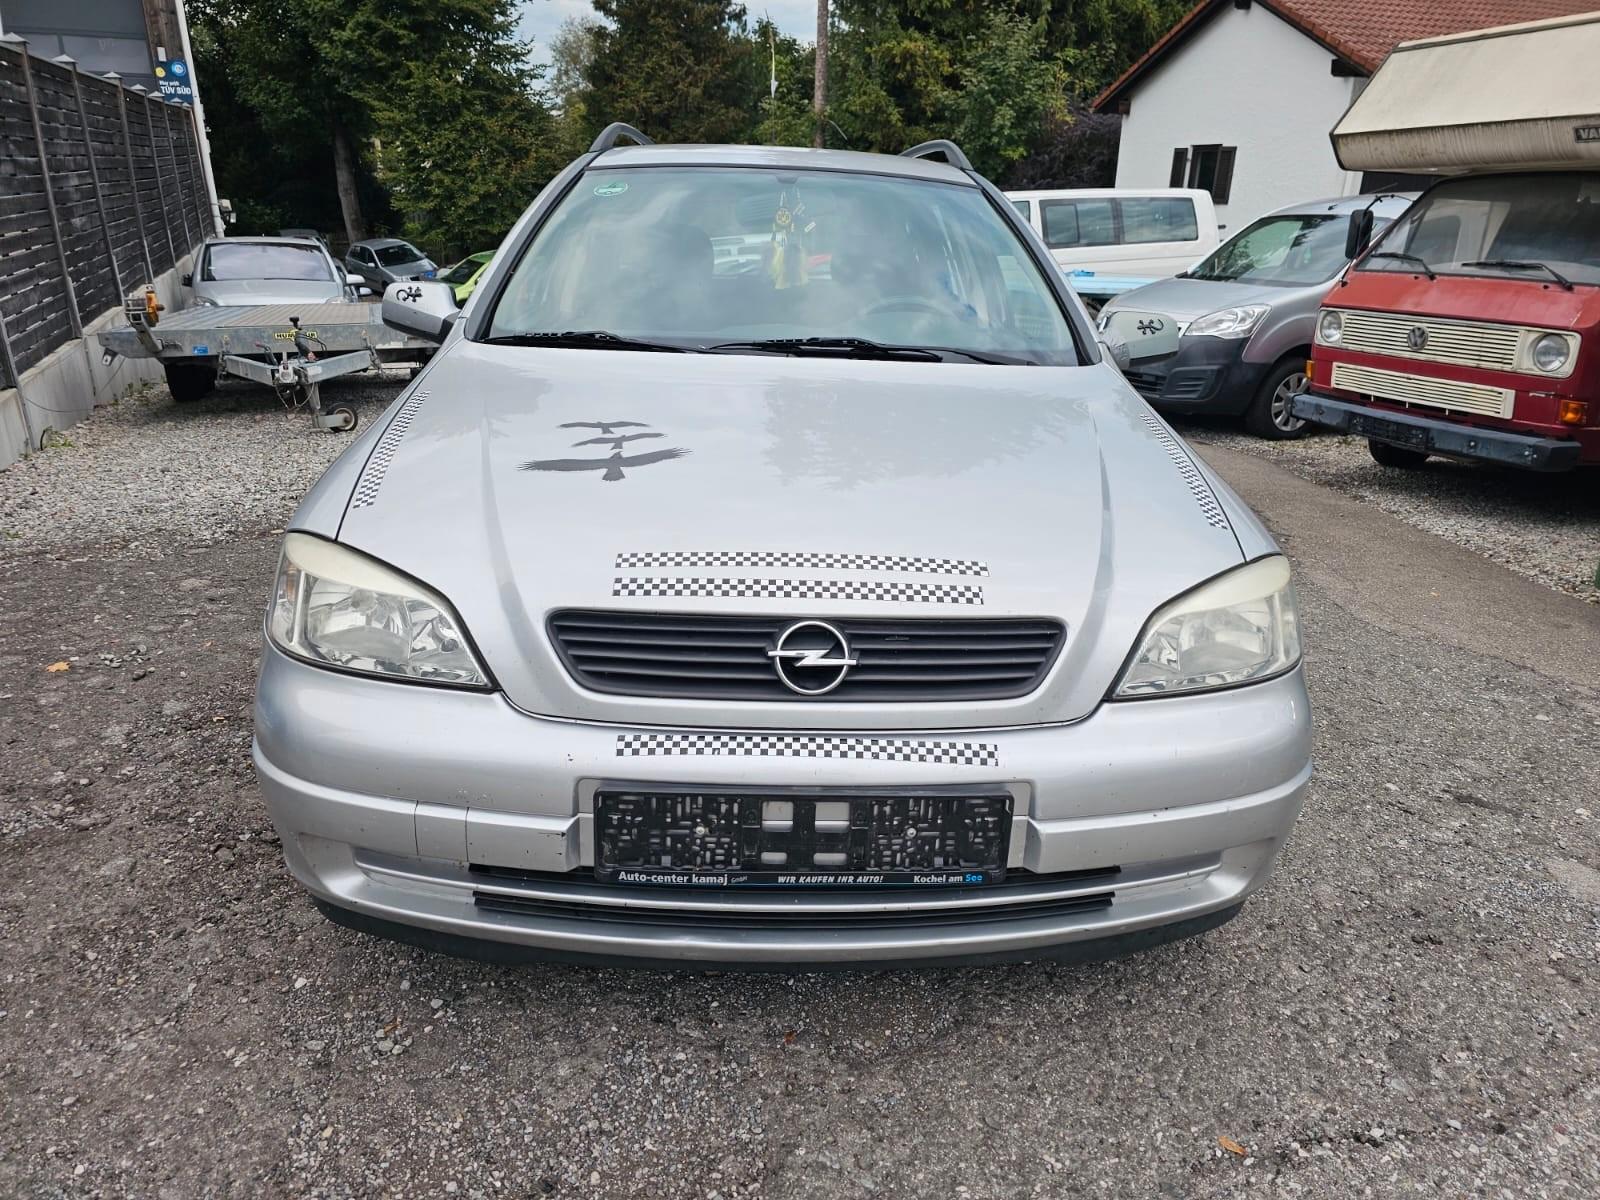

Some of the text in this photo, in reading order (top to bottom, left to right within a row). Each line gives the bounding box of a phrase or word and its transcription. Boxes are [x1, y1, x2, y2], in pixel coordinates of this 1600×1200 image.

[161, 85, 191, 95] TÜV SÜD
[1579, 127, 1600, 140] VA
[618, 871, 689, 884] Auto-center
[692, 873, 728, 886] kamaj
[856, 875, 883, 883] AUTO!
[913, 874, 946, 883] Kochel
